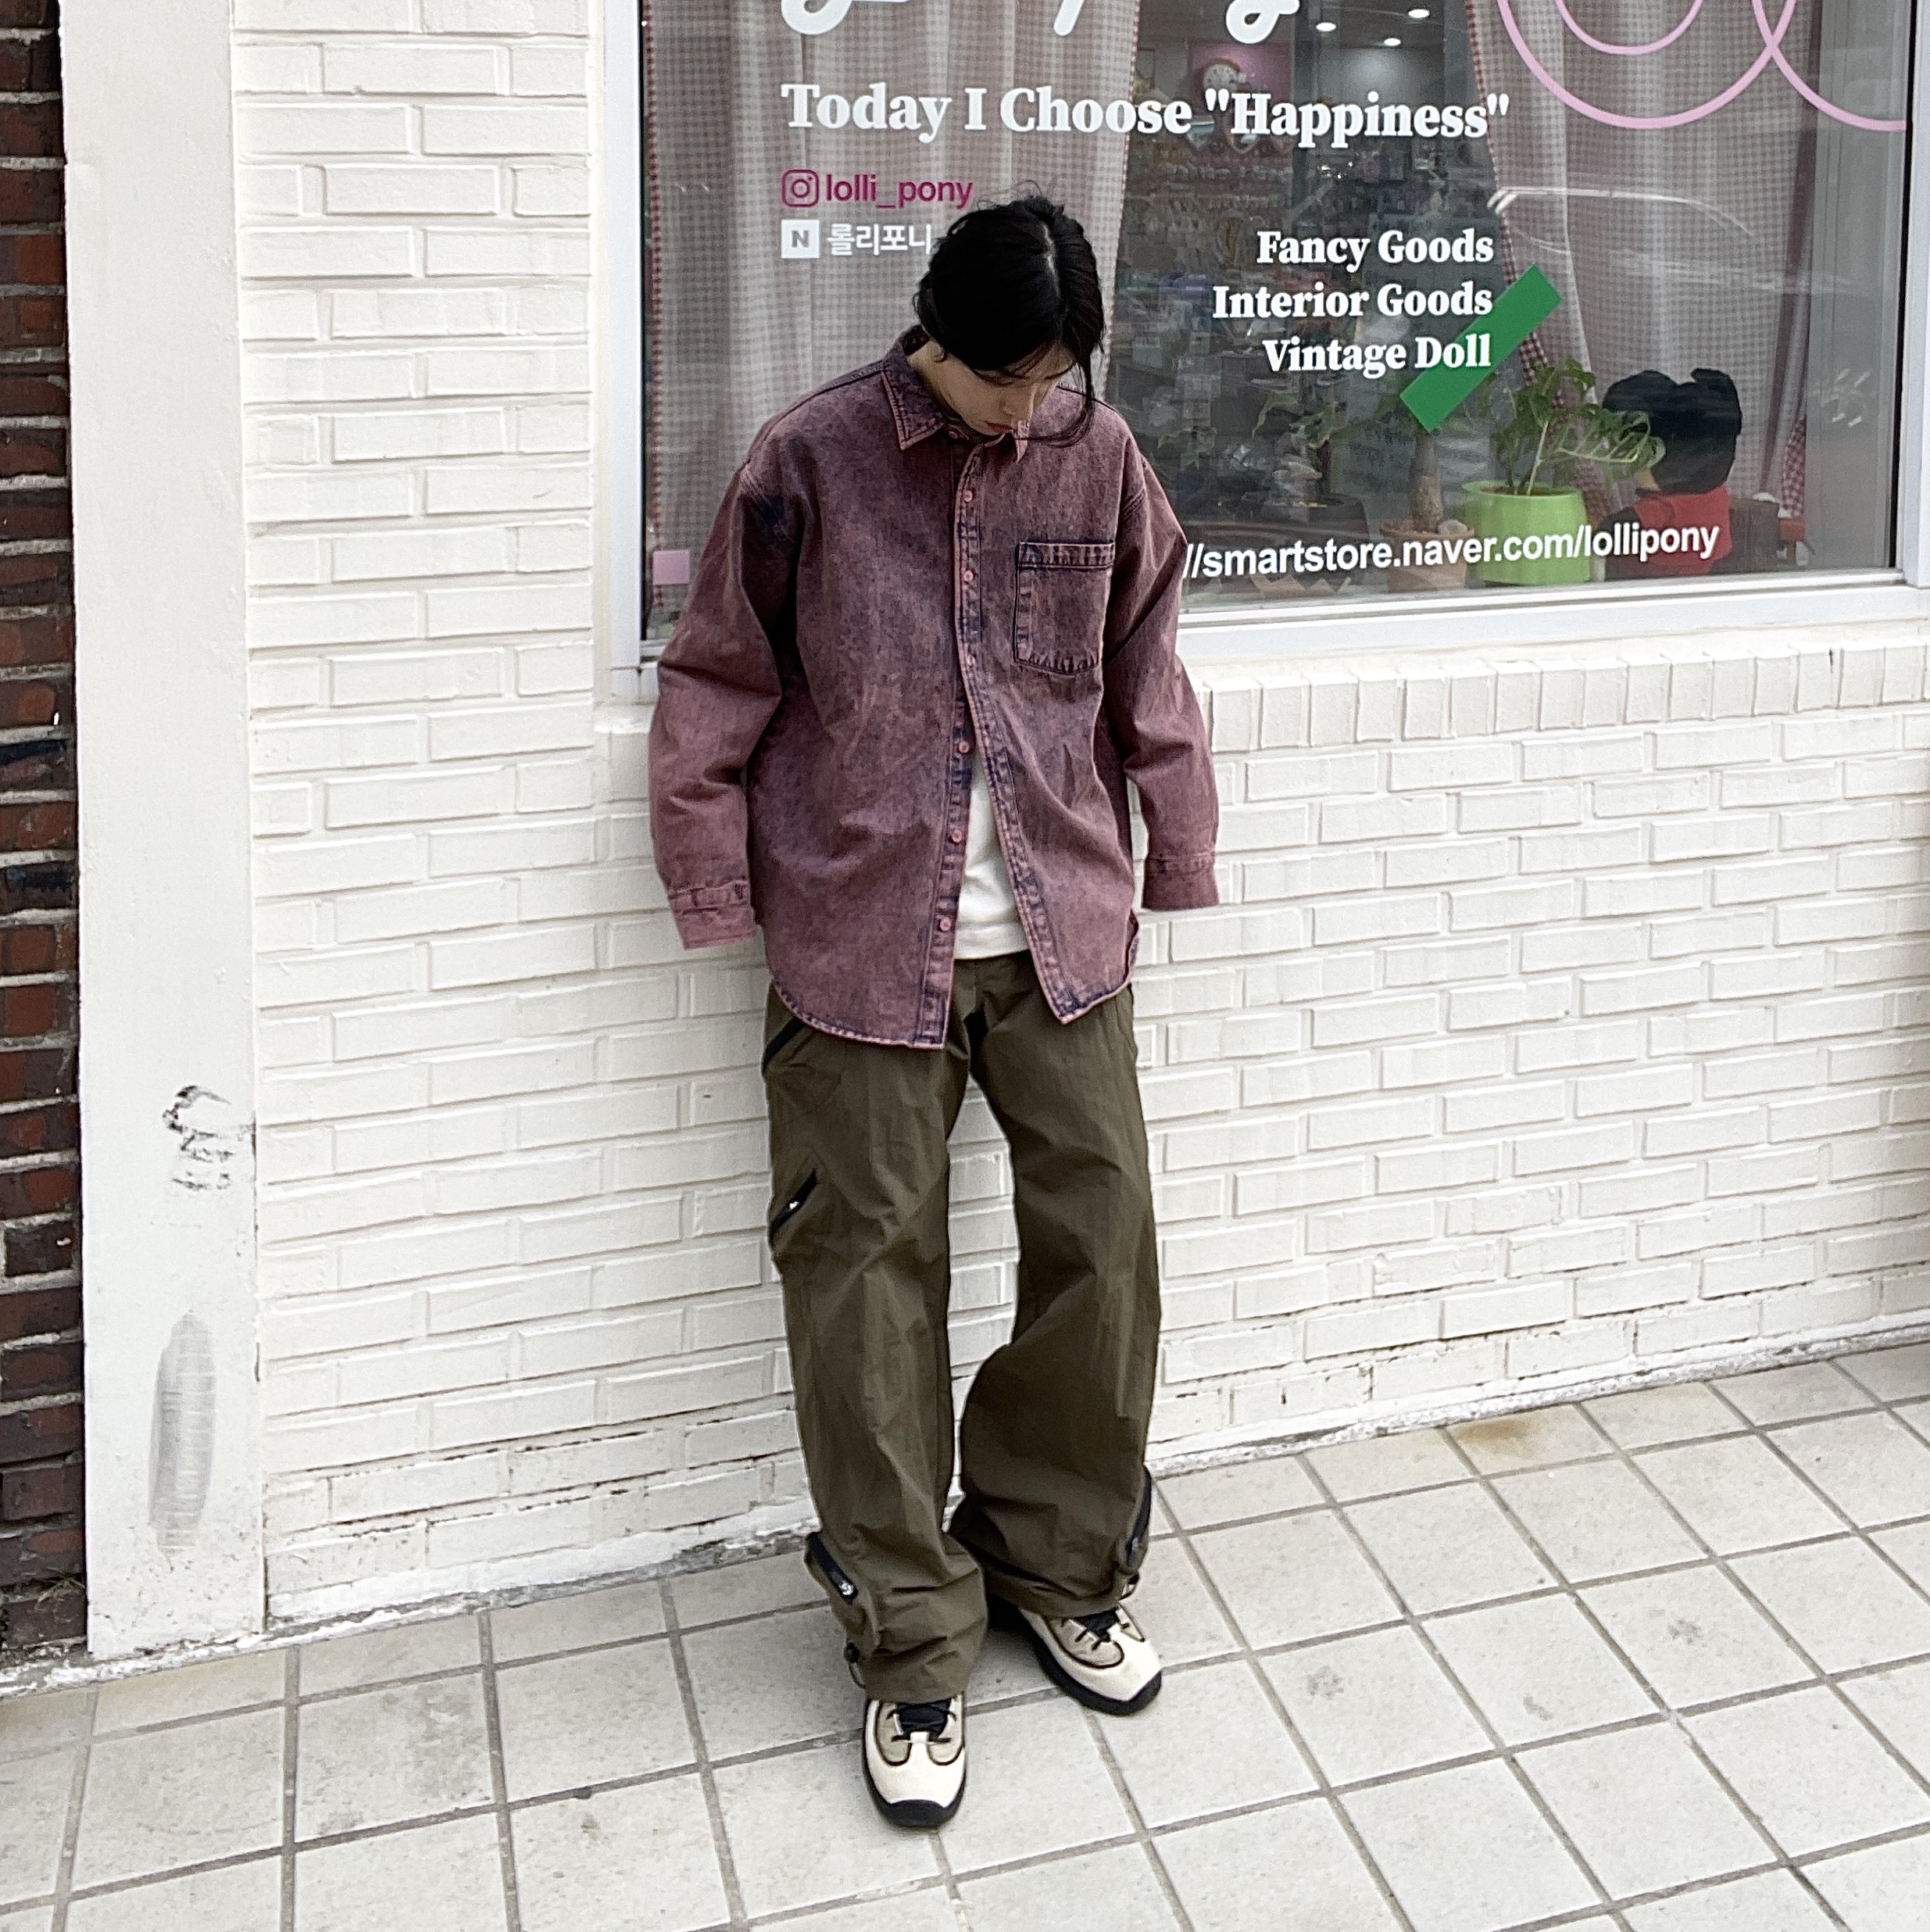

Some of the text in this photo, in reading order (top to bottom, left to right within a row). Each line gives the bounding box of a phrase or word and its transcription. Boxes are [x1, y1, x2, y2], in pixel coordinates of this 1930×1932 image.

[781, 81, 1510, 148] Today I Choose "Happiness"
[826, 174, 974, 209] lolli_pony
[826, 223, 932, 256] 롤리포니
[1256, 227, 1494, 273] Fancy Goods
[1213, 281, 1492, 318] Interior Goods
[1262, 334, 1491, 379] Vintage Doll
[1182, 522, 1719, 579] //smartstore.naver.com/lollipony
